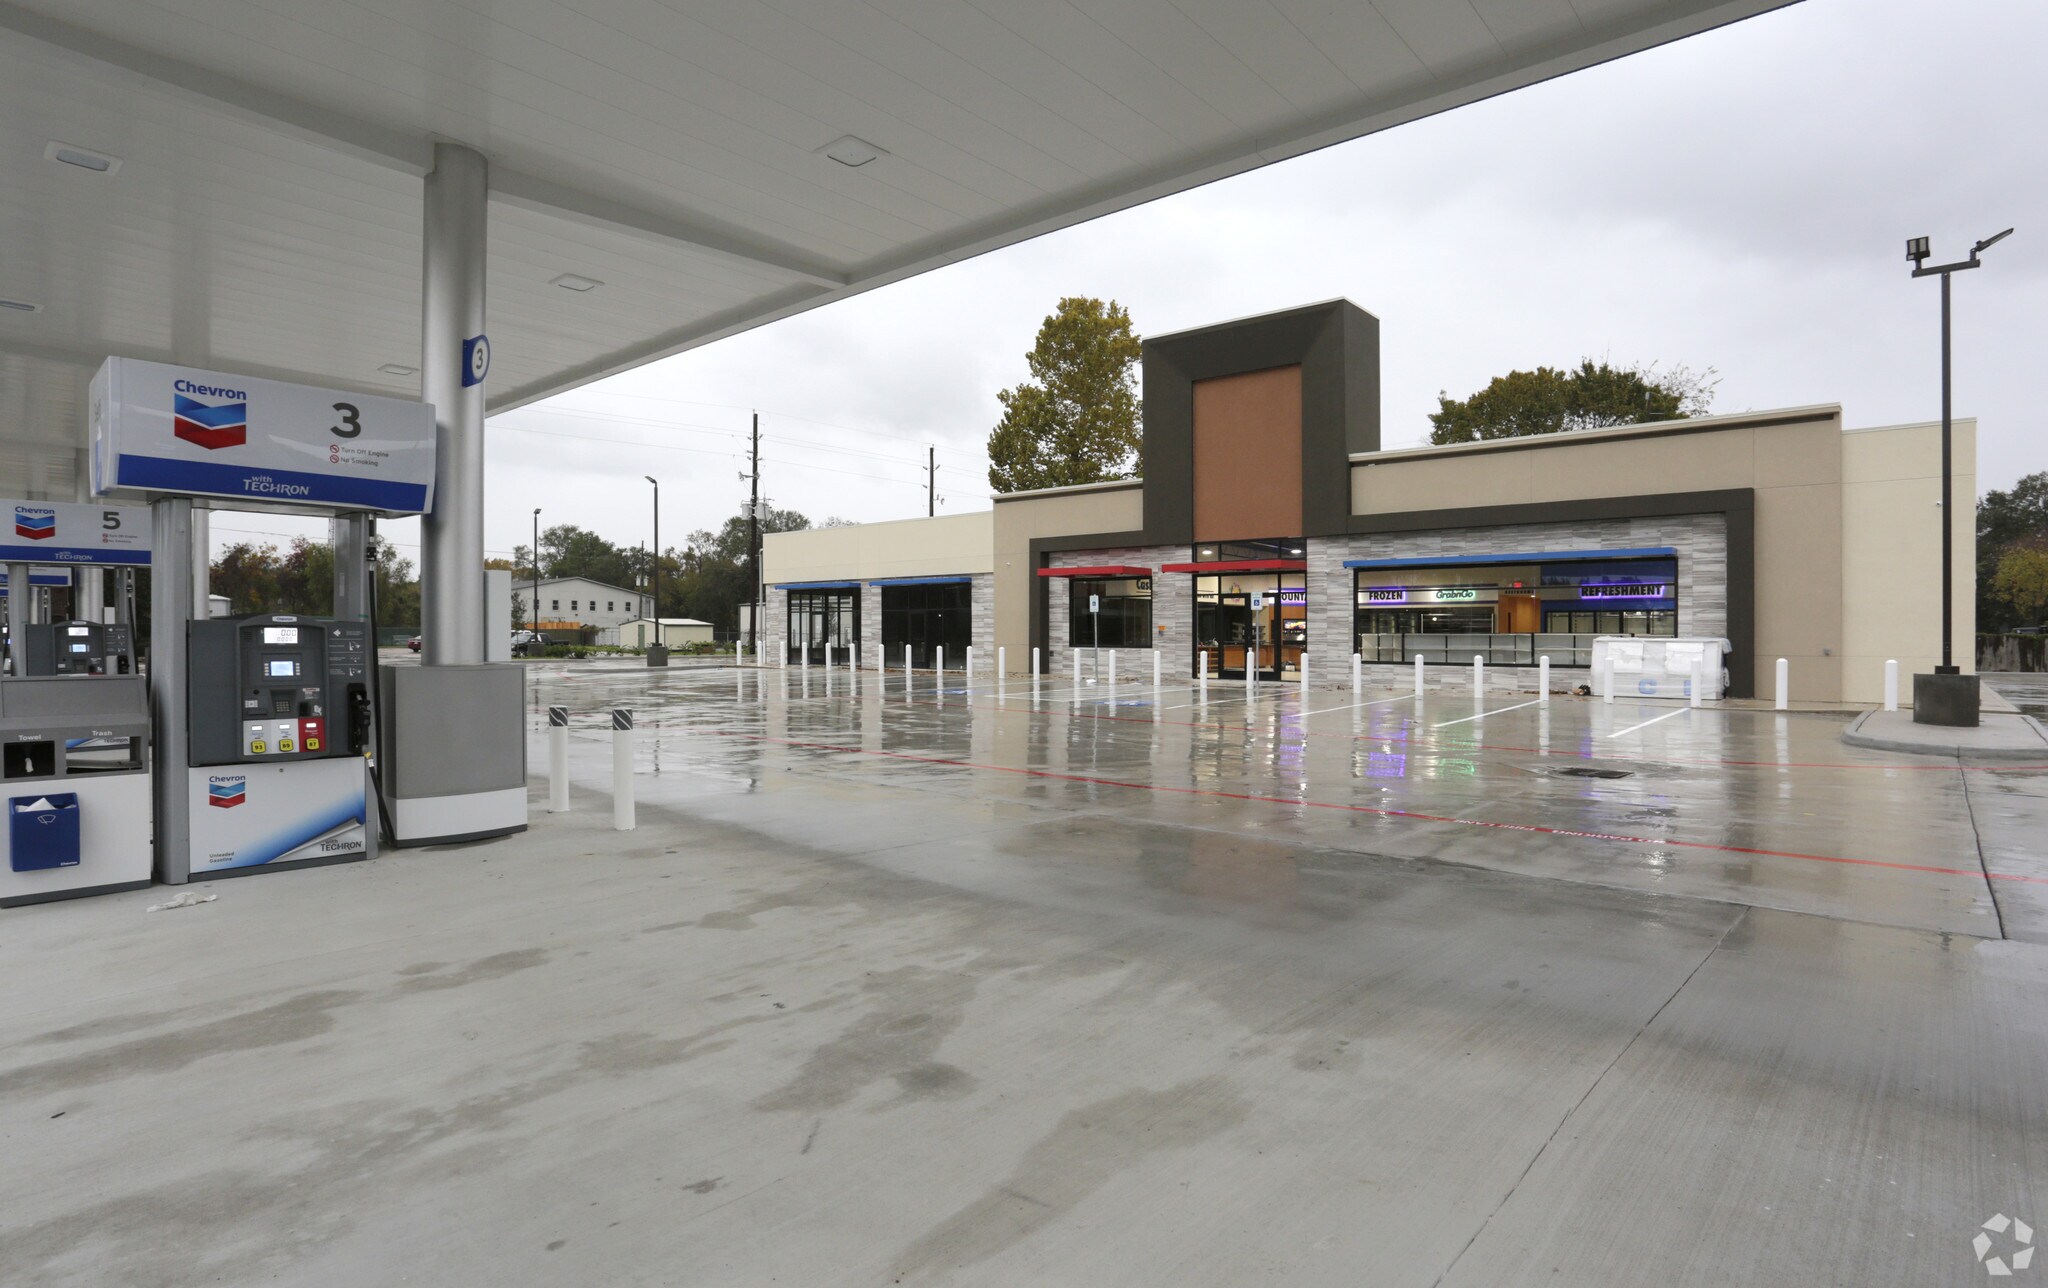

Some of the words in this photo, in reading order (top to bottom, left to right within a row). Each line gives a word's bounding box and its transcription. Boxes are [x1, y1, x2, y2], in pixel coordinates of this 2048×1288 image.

[476, 348, 483, 370] 3
[174, 379, 247, 401] Chevron
[330, 402, 361, 439] 3
[341, 446, 356, 454] Turn
[368, 450, 389, 458] Engine
[351, 458, 379, 467] Smoking
[252, 475, 273, 483] with
[243, 479, 309, 496] TECHRON
[15, 506, 56, 514] Chevron
[102, 511, 121, 530] 5
[54, 553, 93, 561] TECHRON
[1136, 579, 1150, 590] Cas
[1369, 590, 1403, 600] FROZEN
[1581, 585, 1664, 596] REFRESHMENT
[320, 842, 362, 852] TECHRON
